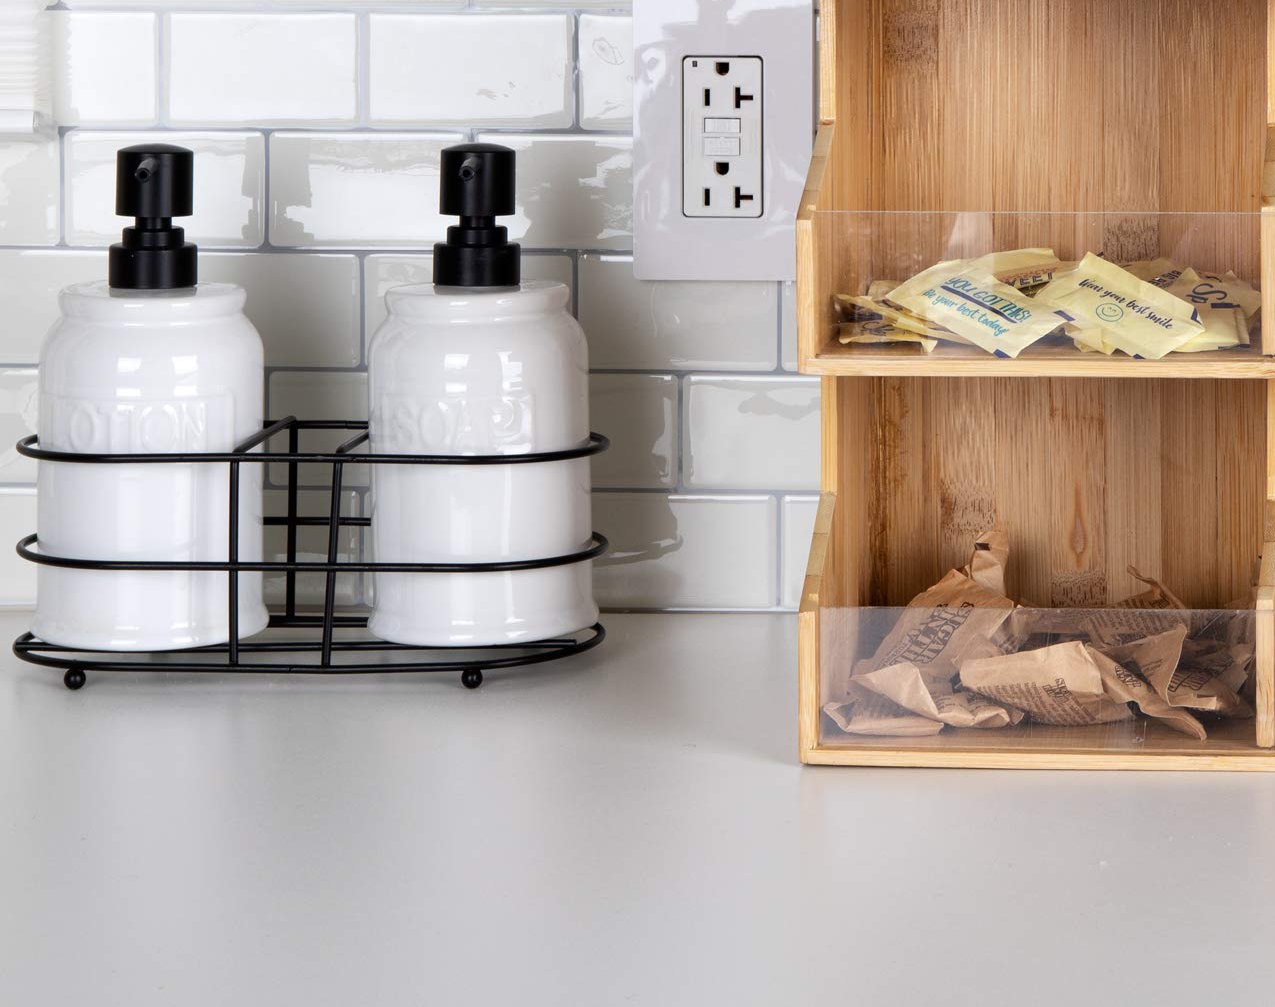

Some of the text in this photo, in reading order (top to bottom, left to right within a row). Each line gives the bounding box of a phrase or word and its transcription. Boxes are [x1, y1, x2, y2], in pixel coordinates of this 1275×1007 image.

[922, 288, 936, 299] Be
[931, 295, 958, 307] your
[956, 303, 980, 319] best
[944, 277, 1032, 323] YOU GOT THIS!
[1078, 278, 1173, 329] Wear your best smile
[53, 401, 207, 454] OTION
[390, 398, 518, 454] SOAP
